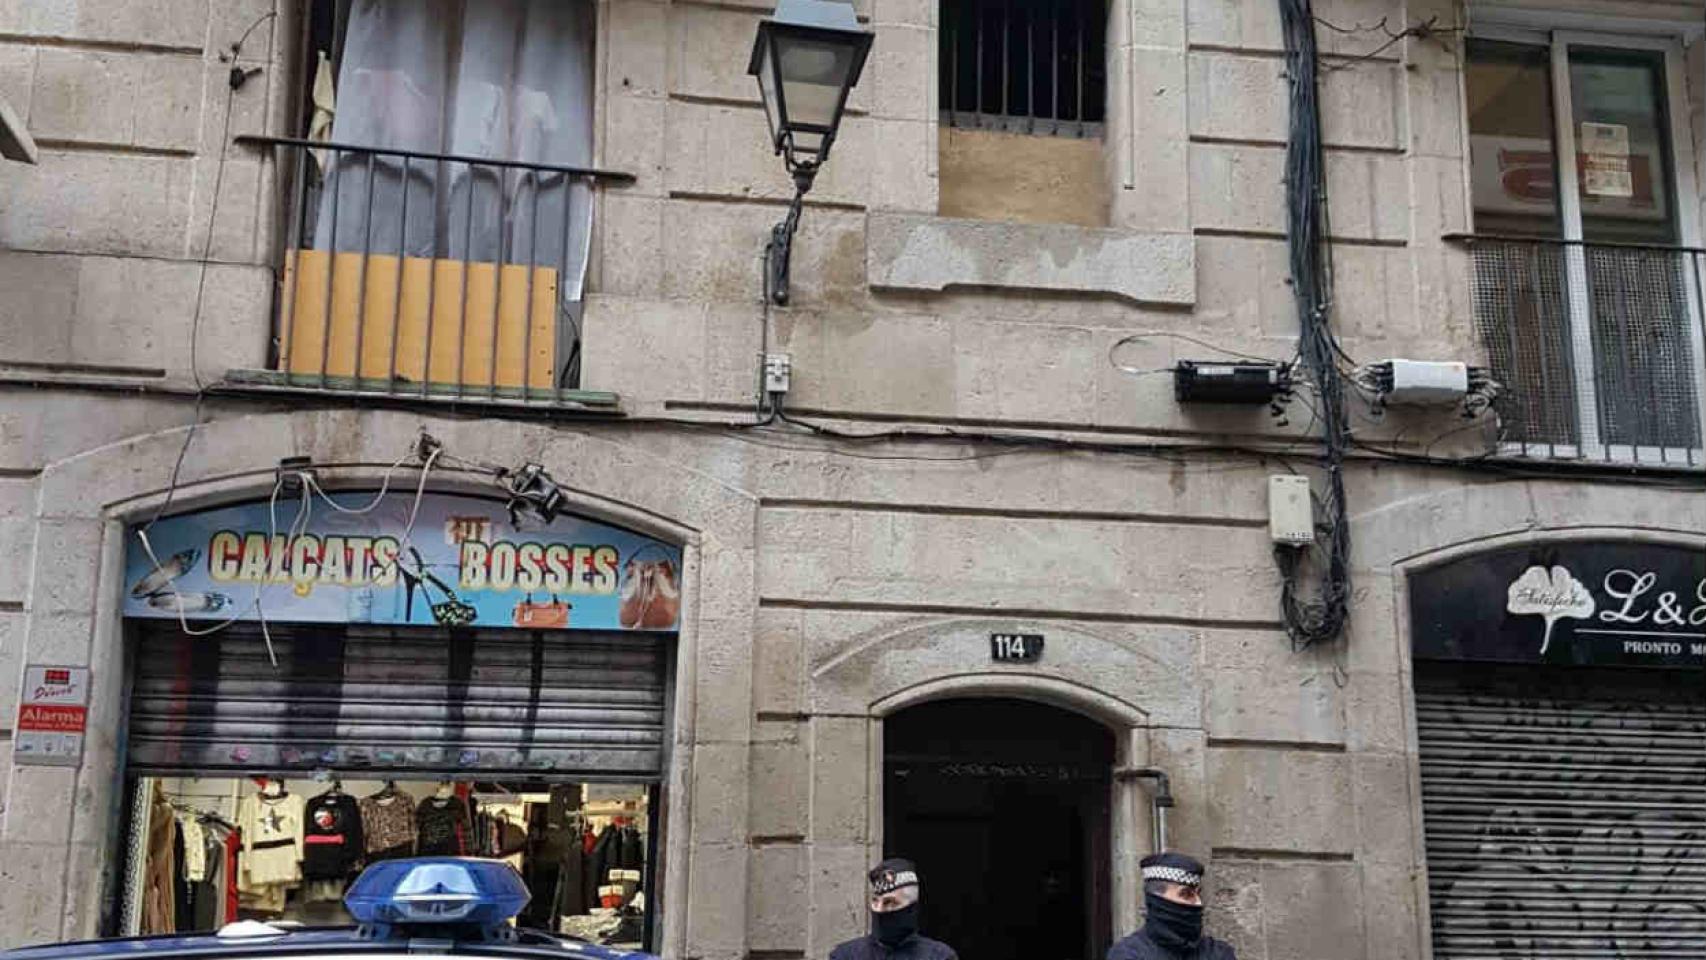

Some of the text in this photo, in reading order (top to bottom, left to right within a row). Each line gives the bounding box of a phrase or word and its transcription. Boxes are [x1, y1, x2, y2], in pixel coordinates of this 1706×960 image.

[210, 530, 401, 597] CALÇATS
[460, 540, 620, 595] BOSSES
[995, 635, 1026, 658] 114
[1624, 641, 1682, 655] PRONTO
[22, 707, 84, 722] Alarma
